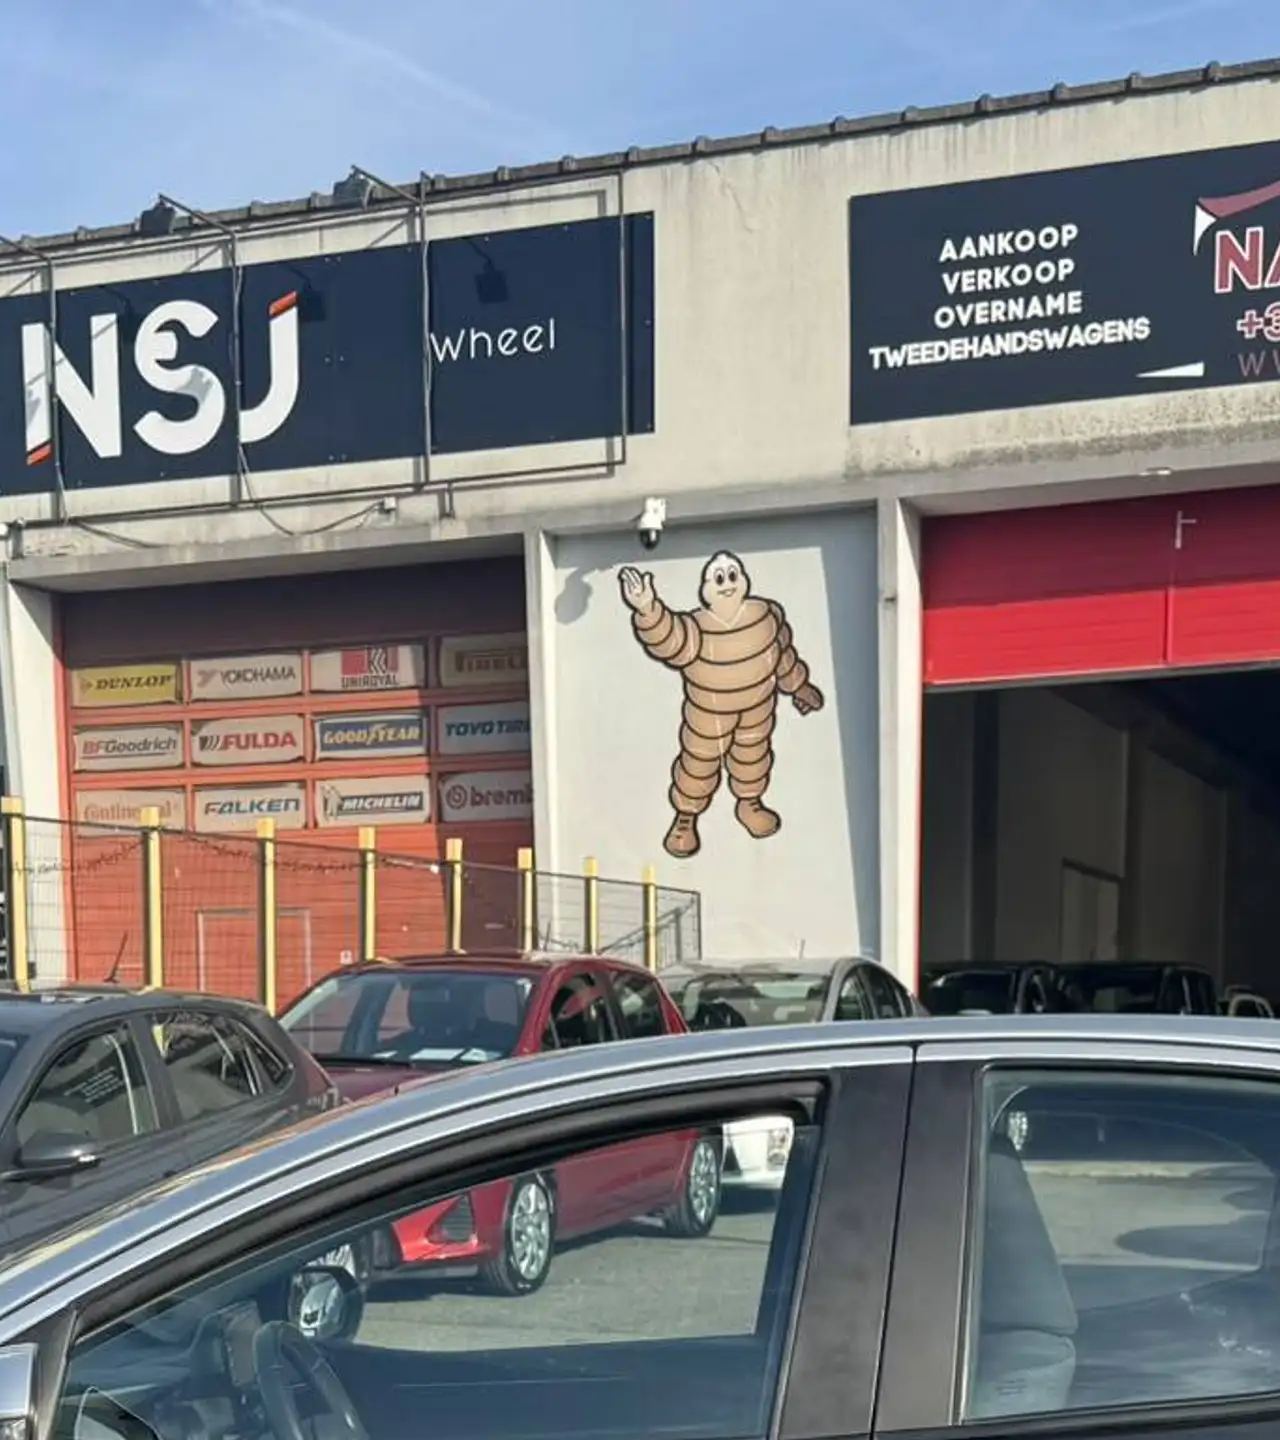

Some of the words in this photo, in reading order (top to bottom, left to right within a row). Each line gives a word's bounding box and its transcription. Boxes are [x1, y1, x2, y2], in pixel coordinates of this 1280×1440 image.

[939, 224, 1078, 262] AANKOOP
[942, 259, 1075, 296] VERKOOP
[934, 291, 1083, 330] OVERNAME
[430, 318, 557, 363] Wheel
[869, 317, 1151, 370] TWEEDEHANDSWAGENS
[21, 290, 298, 466] NSJ
[95, 674, 174, 691] DUNLOP
[221, 665, 296, 688] YOKOHAMA
[341, 674, 399, 689] UNIROYAL
[324, 722, 420, 745] GOODYEAR
[445, 720, 495, 737] TOYO
[82, 735, 178, 755] BFGoodrich
[220, 731, 297, 750] FULDA
[204, 797, 301, 815] FALKEN
[342, 793, 421, 811] MICHELIN
